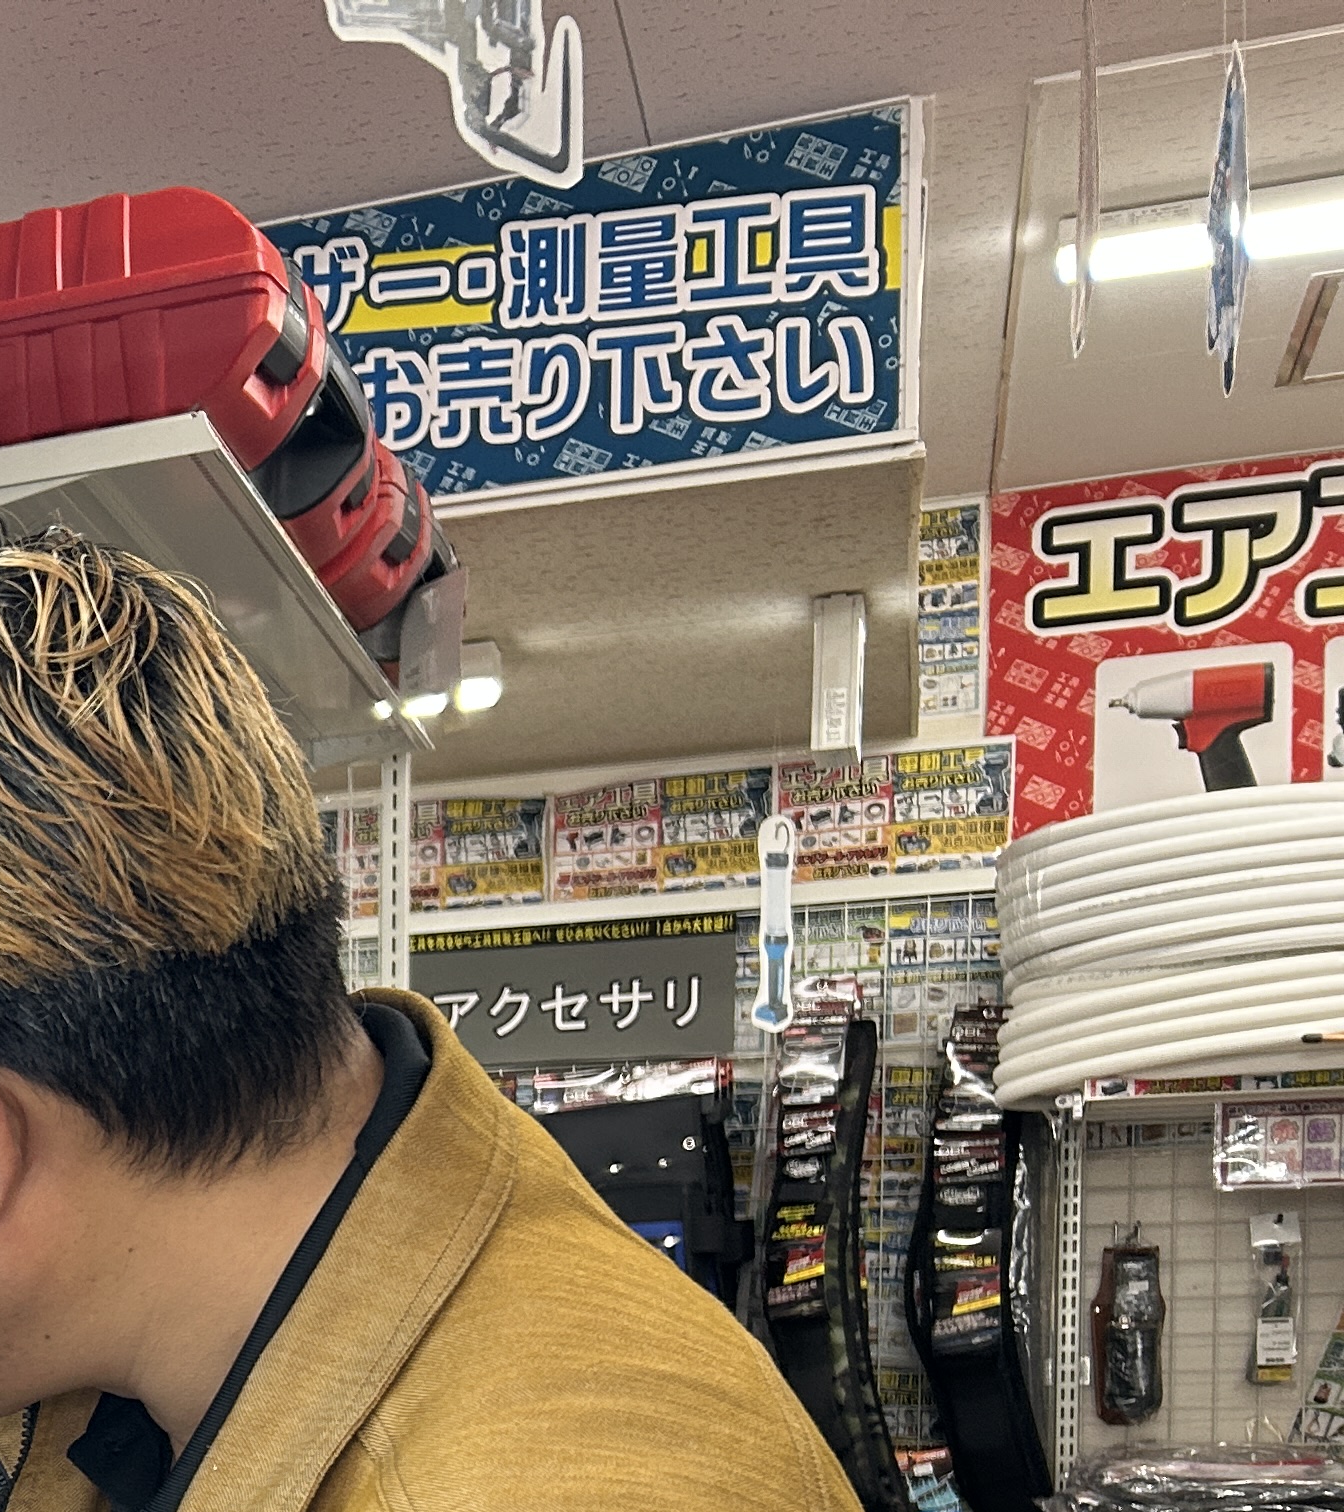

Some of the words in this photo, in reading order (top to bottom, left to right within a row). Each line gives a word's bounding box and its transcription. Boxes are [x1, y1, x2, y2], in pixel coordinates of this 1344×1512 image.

[358, 313, 874, 450] お売り下さい
[433, 975, 702, 1037] アクセサリ
